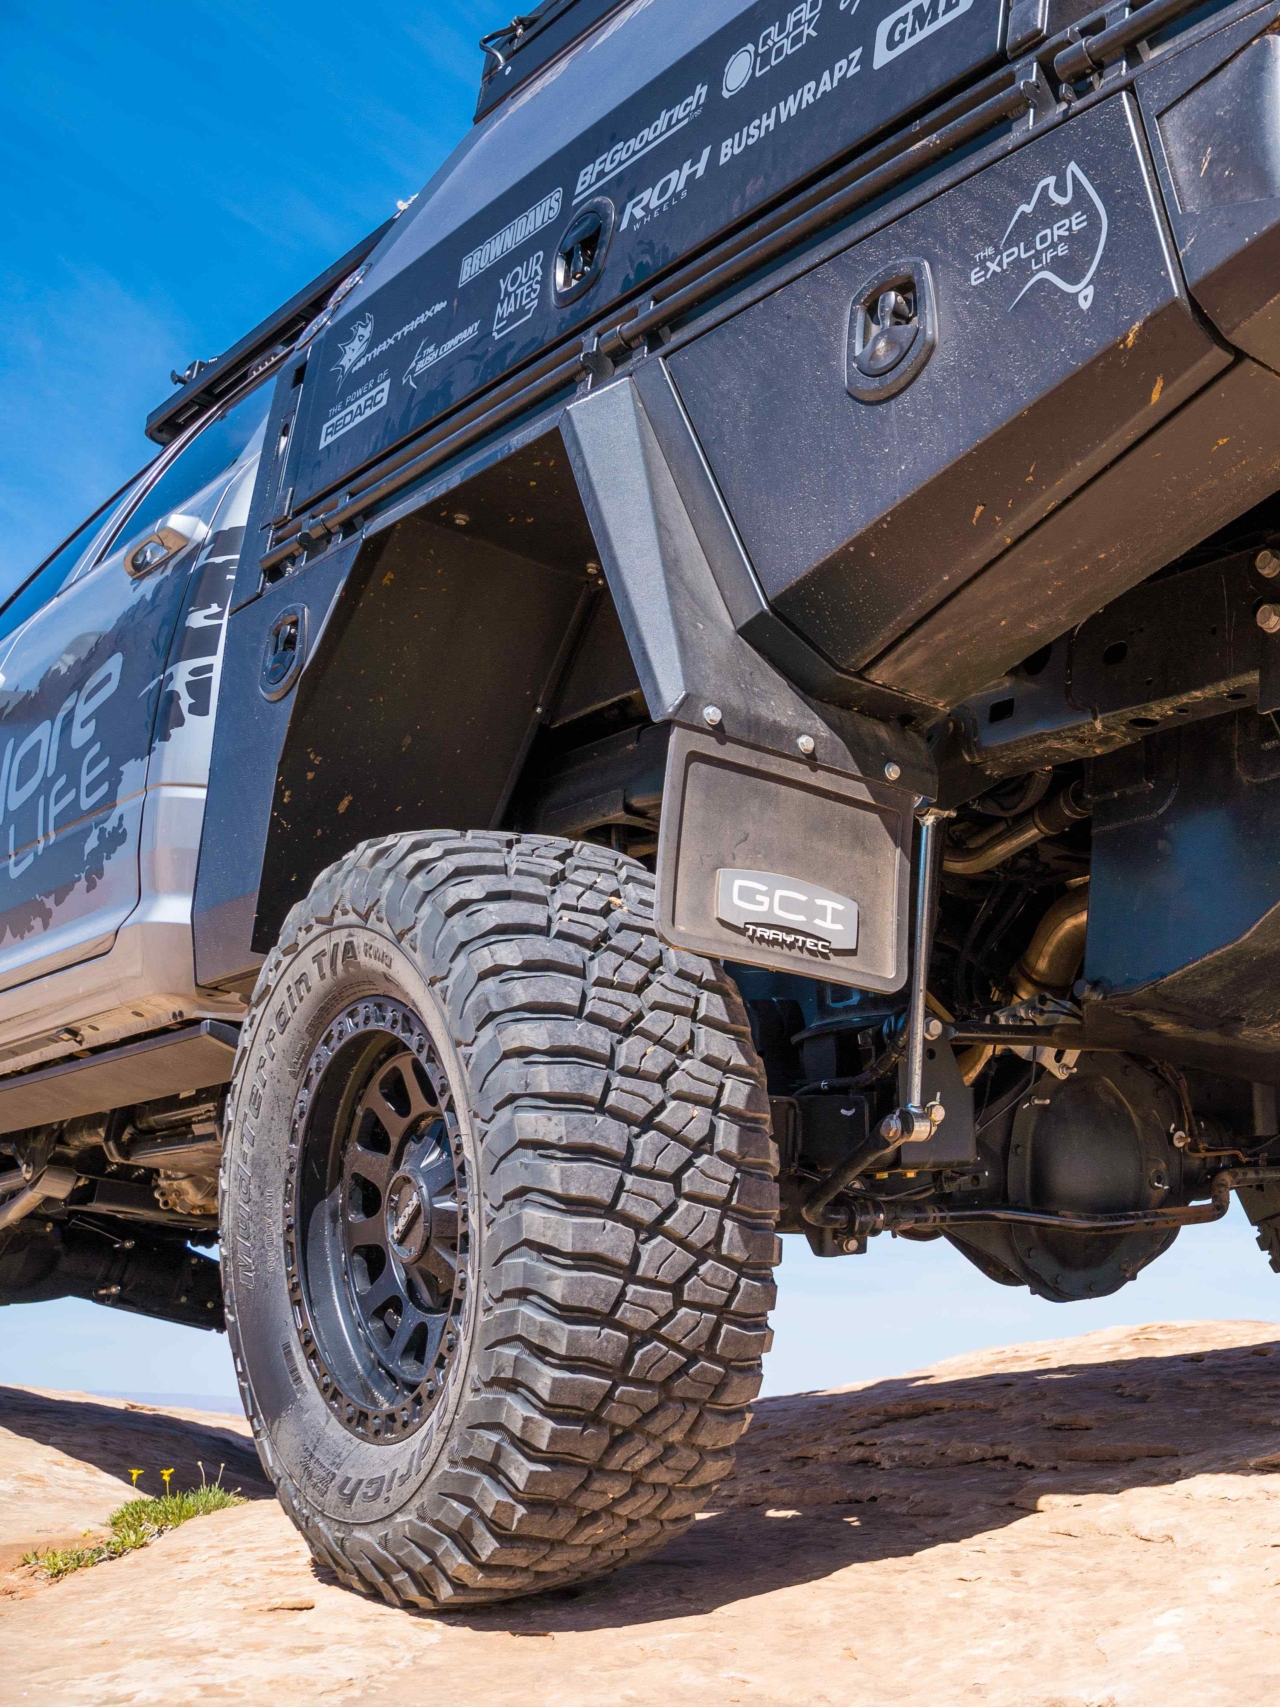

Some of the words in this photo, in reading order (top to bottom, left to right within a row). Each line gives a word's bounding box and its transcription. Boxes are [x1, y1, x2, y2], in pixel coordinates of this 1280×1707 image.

[755, 13, 820, 78] LOCK
[758, 0, 822, 54] QUAD
[574, 83, 708, 196] BFGoodrich
[619, 145, 712, 232] ROH
[633, 189, 687, 232] WHEELS
[970, 211, 1088, 286] EXPLORE
[974, 245, 995, 263] THE
[1031, 242, 1069, 271] LIFE
[495, 275, 541, 319] MATES
[499, 251, 544, 300] YOUR
[439, 319, 481, 356] COMPANY
[323, 387, 386, 443] REDARC
[328, 402, 343, 417] THE
[345, 380, 374, 405] POWER
[377, 369, 389, 383] OF
[9, 741, 110, 880] LIFE
[732, 879, 845, 930] GCI
[312, 939, 360, 981] T/A
[744, 924, 831, 954] TRAYTEC
